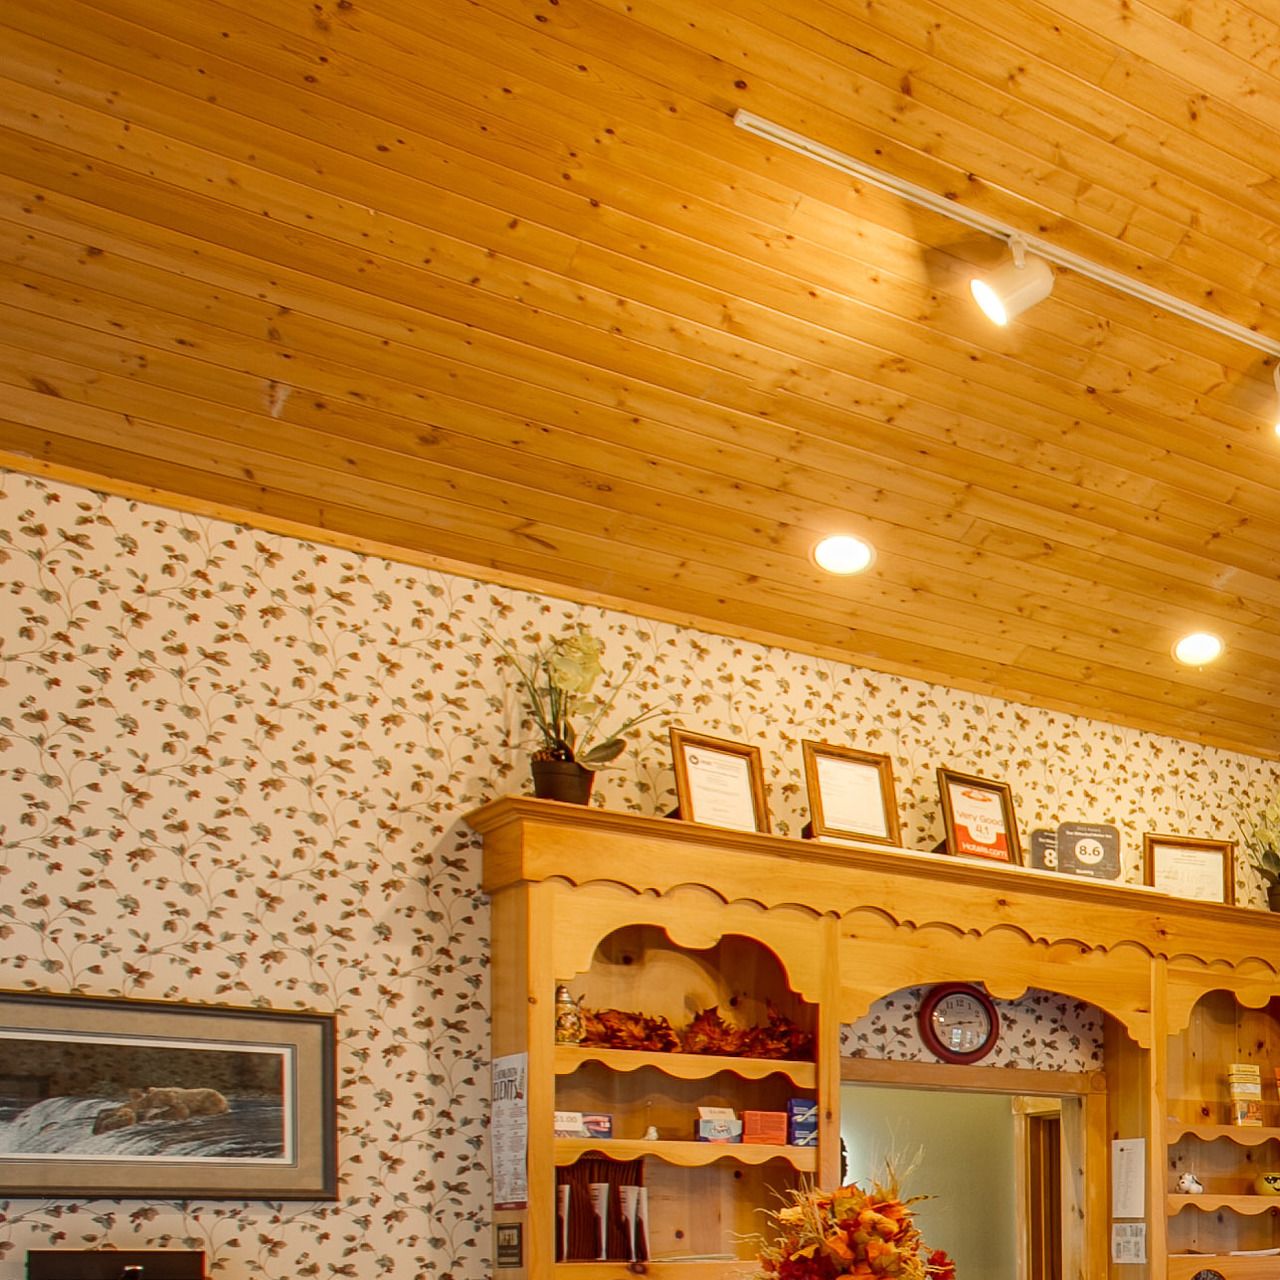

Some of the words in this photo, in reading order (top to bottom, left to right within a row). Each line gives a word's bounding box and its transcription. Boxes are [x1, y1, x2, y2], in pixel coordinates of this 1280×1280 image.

[1079, 845, 1101, 856] 8.6
[946, 1001, 954, 1009] 11
[956, 999, 964, 1007] 12
